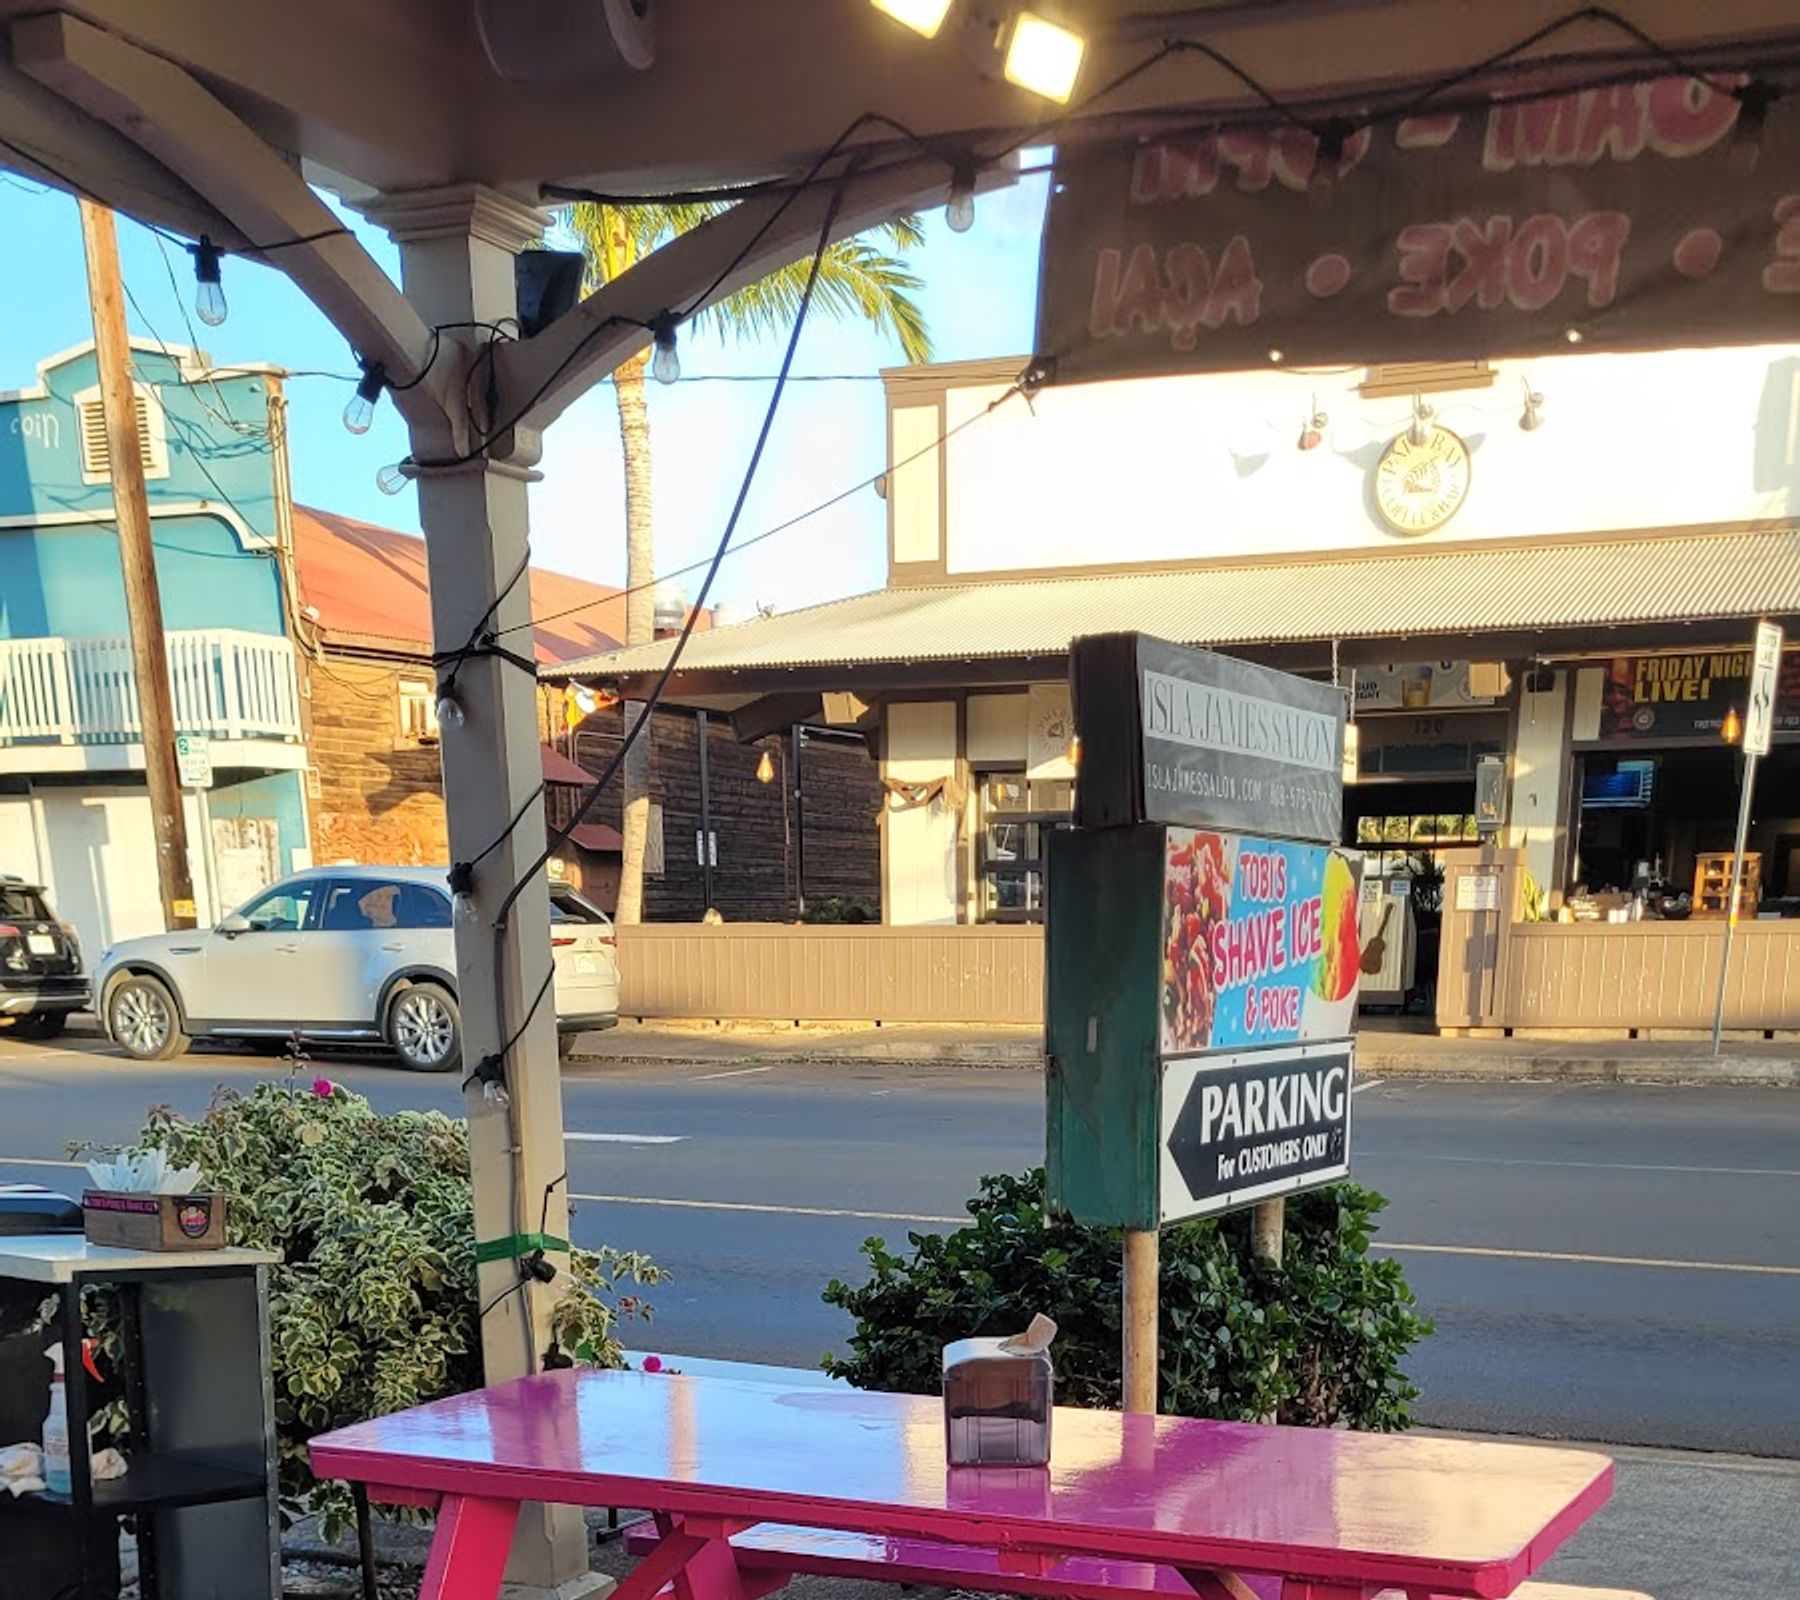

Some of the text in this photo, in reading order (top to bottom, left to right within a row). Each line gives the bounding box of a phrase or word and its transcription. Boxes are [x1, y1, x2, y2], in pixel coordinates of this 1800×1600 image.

[1634, 677, 1712, 704] LIVE!
[1636, 654, 1705, 682] FRIDAY
[1148, 678, 1335, 766] ISLA JAMES SALON
[1413, 718, 1445, 734] 120
[1147, 762, 1262, 802] ISLAJAMESSALON.COM
[1239, 852, 1286, 901] TOBI'S
[1212, 896, 1323, 990] SHAVE ICE
[1244, 985, 1300, 1032] & POKE
[1200, 1066, 1345, 1145] PARKING
[1217, 1132, 1329, 1181] For CUSTOMERS ONLY
